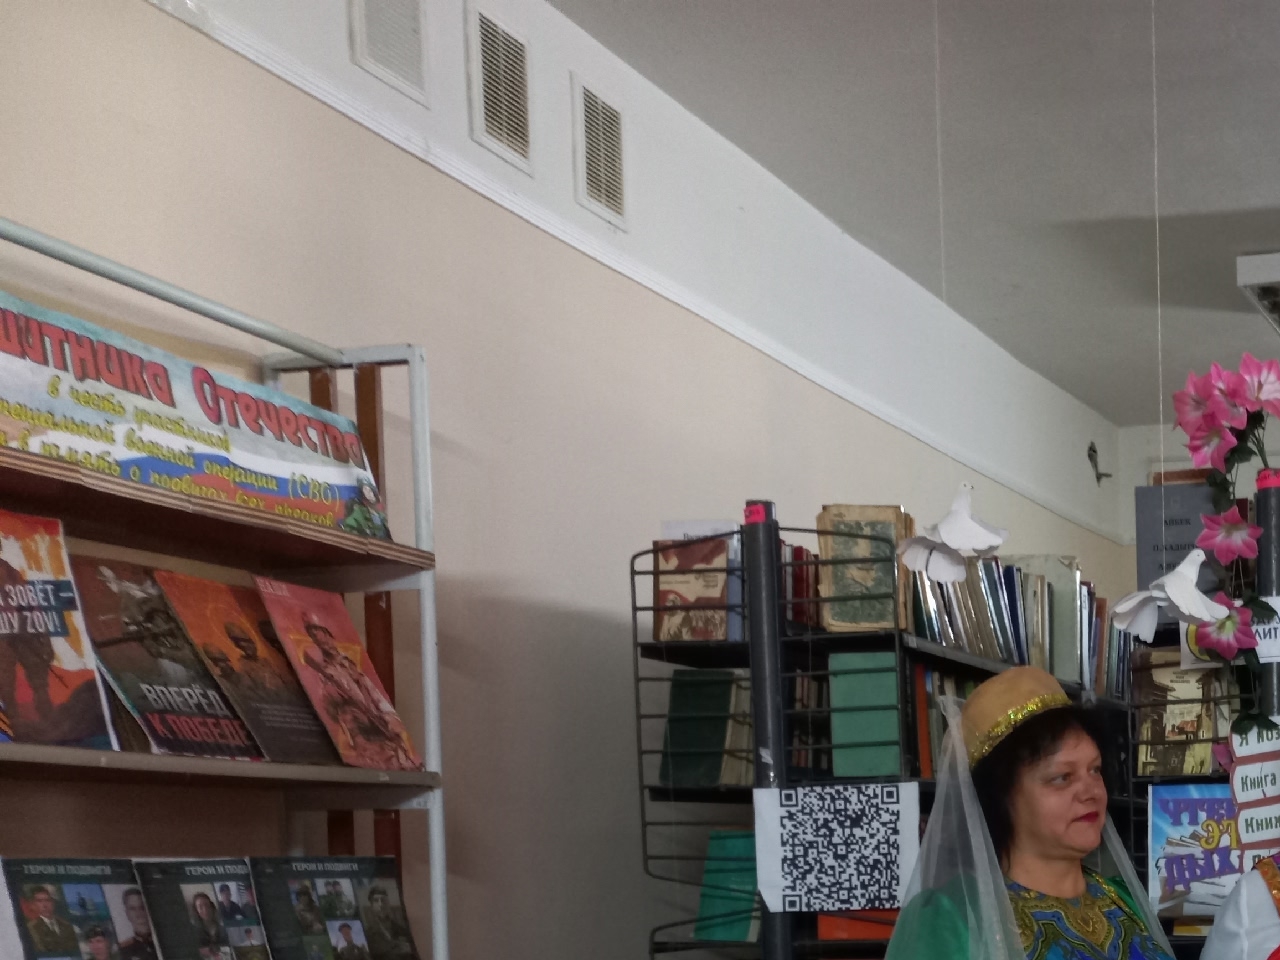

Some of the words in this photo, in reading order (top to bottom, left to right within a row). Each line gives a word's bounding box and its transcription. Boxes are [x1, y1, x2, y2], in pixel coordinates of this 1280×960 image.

[191, 366, 366, 470] Отечества
[288, 472, 340, 512] (СВО)
[1241, 772, 1277, 793] Книга
